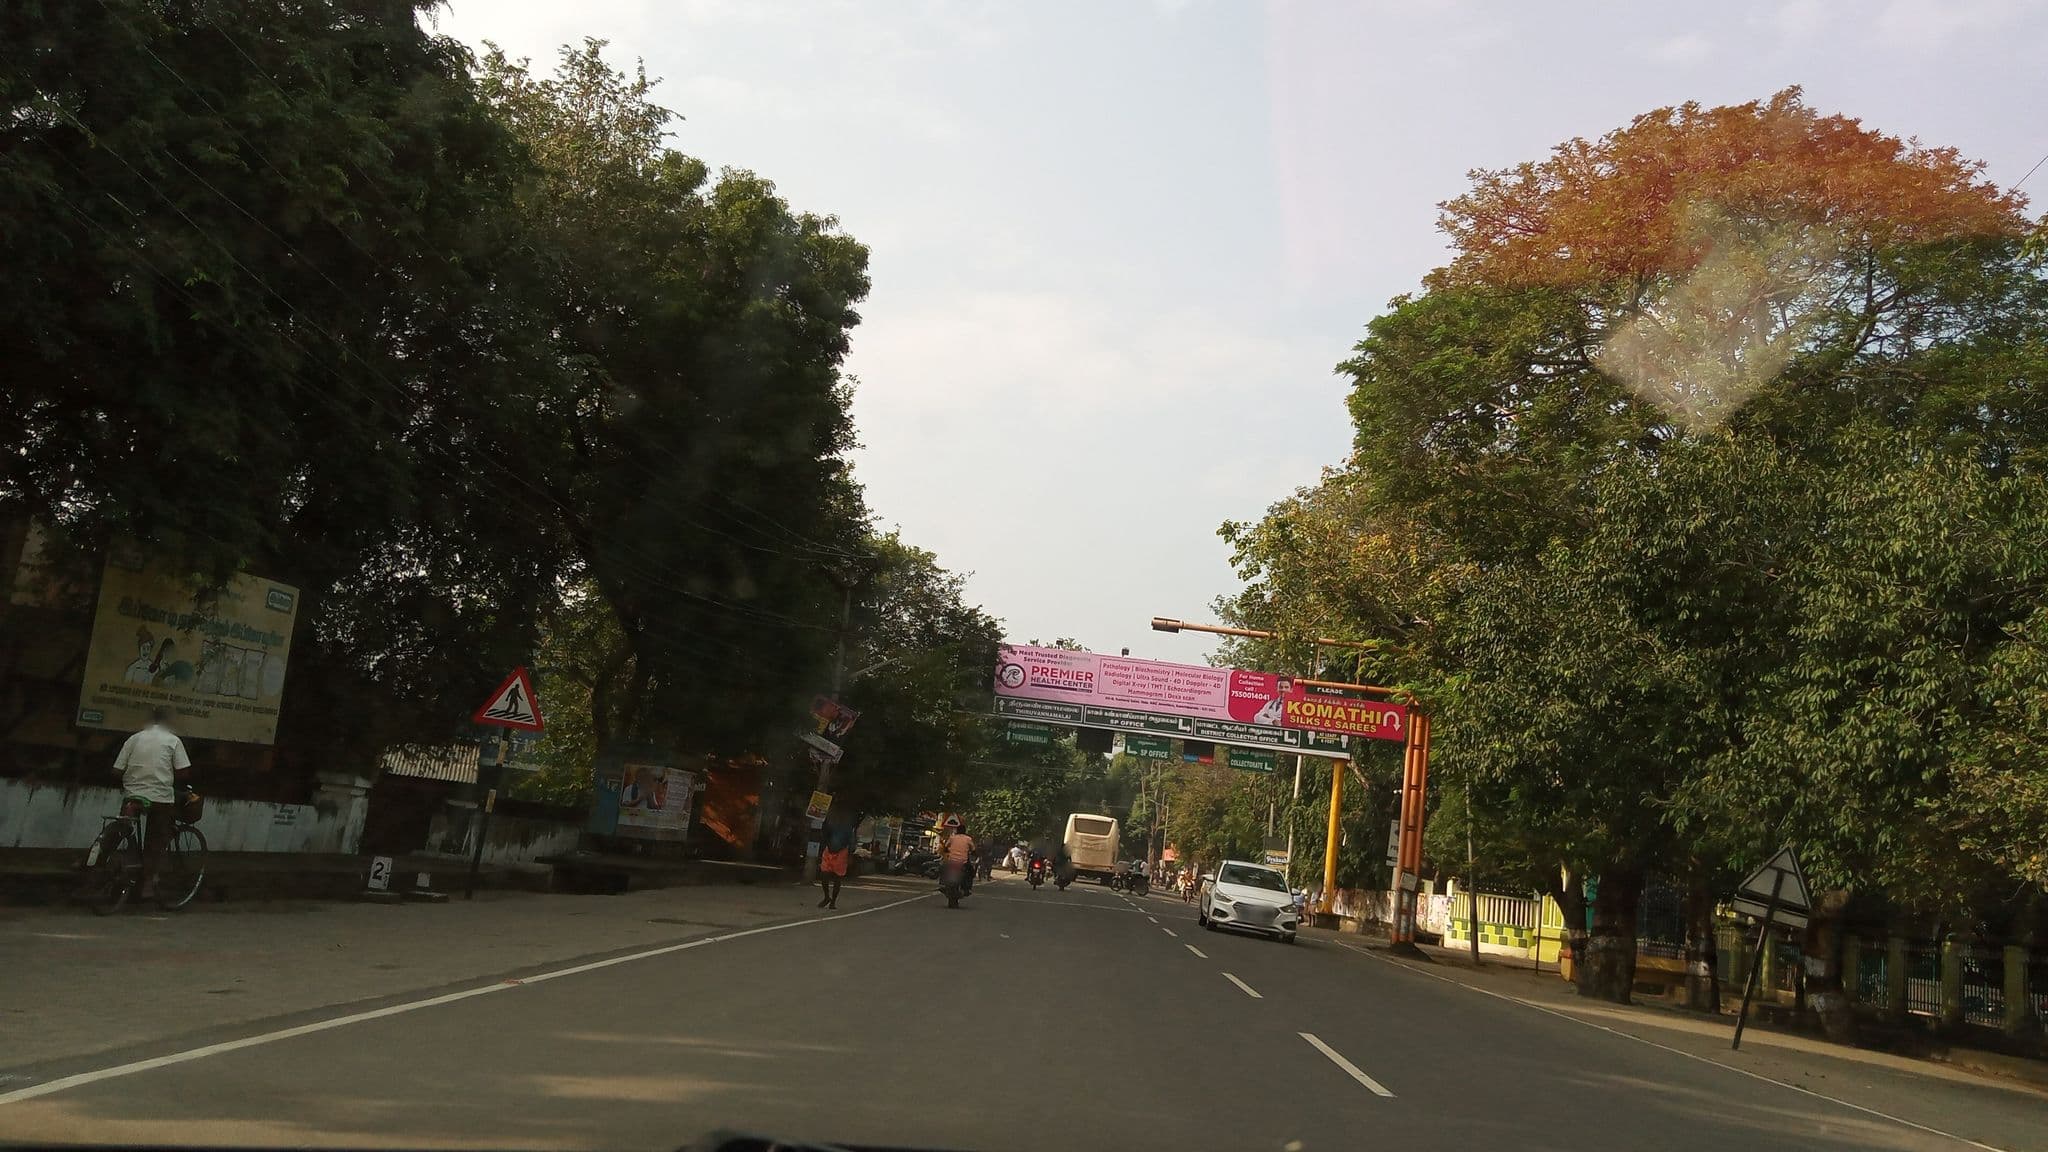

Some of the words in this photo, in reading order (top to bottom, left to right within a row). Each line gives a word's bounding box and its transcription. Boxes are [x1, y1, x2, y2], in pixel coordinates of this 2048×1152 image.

[1035, 651, 1058, 659] Trusted
[1031, 666, 1093, 682] PREMIER
[1103, 663, 1130, 672] Pathology
[1135, 666, 1170, 676] Biochemistry
[1175, 671, 1201, 679] Molecular
[1203, 674, 1223, 683] Biology
[1104, 670, 1131, 680] Radiology
[1186, 679, 1208, 688] Doppler
[1031, 676, 1061, 686] HEALTH
[1062, 680, 1093, 689] CENTER
[1112, 679, 1130, 688] Digital
[1132, 682, 1146, 690] X-ray
[1167, 685, 1211, 696] Echocardiogram
[1238, 679, 1264, 687] Collection
[1128, 689, 1163, 699] Mammogram
[1231, 690, 1270, 700] 7550014041
[1317, 687, 1343, 695] PLEASE
[1287, 700, 1381, 725] KOMATHI
[1120, 720, 1145, 728] OFFICE
[1289, 716, 1320, 726] SILKS
[1324, 720, 1331, 728] &
[1335, 722, 1377, 733] SAREES
[1200, 729, 1225, 738] DISTRICT
[1226, 731, 1258, 741] COLLECTOR
[1258, 735, 1278, 743] OFFICE
[1148, 750, 1169, 759] OFFICE
[1230, 759, 1264, 770] COLLECTORATE
[372, 861, 384, 880] 2
